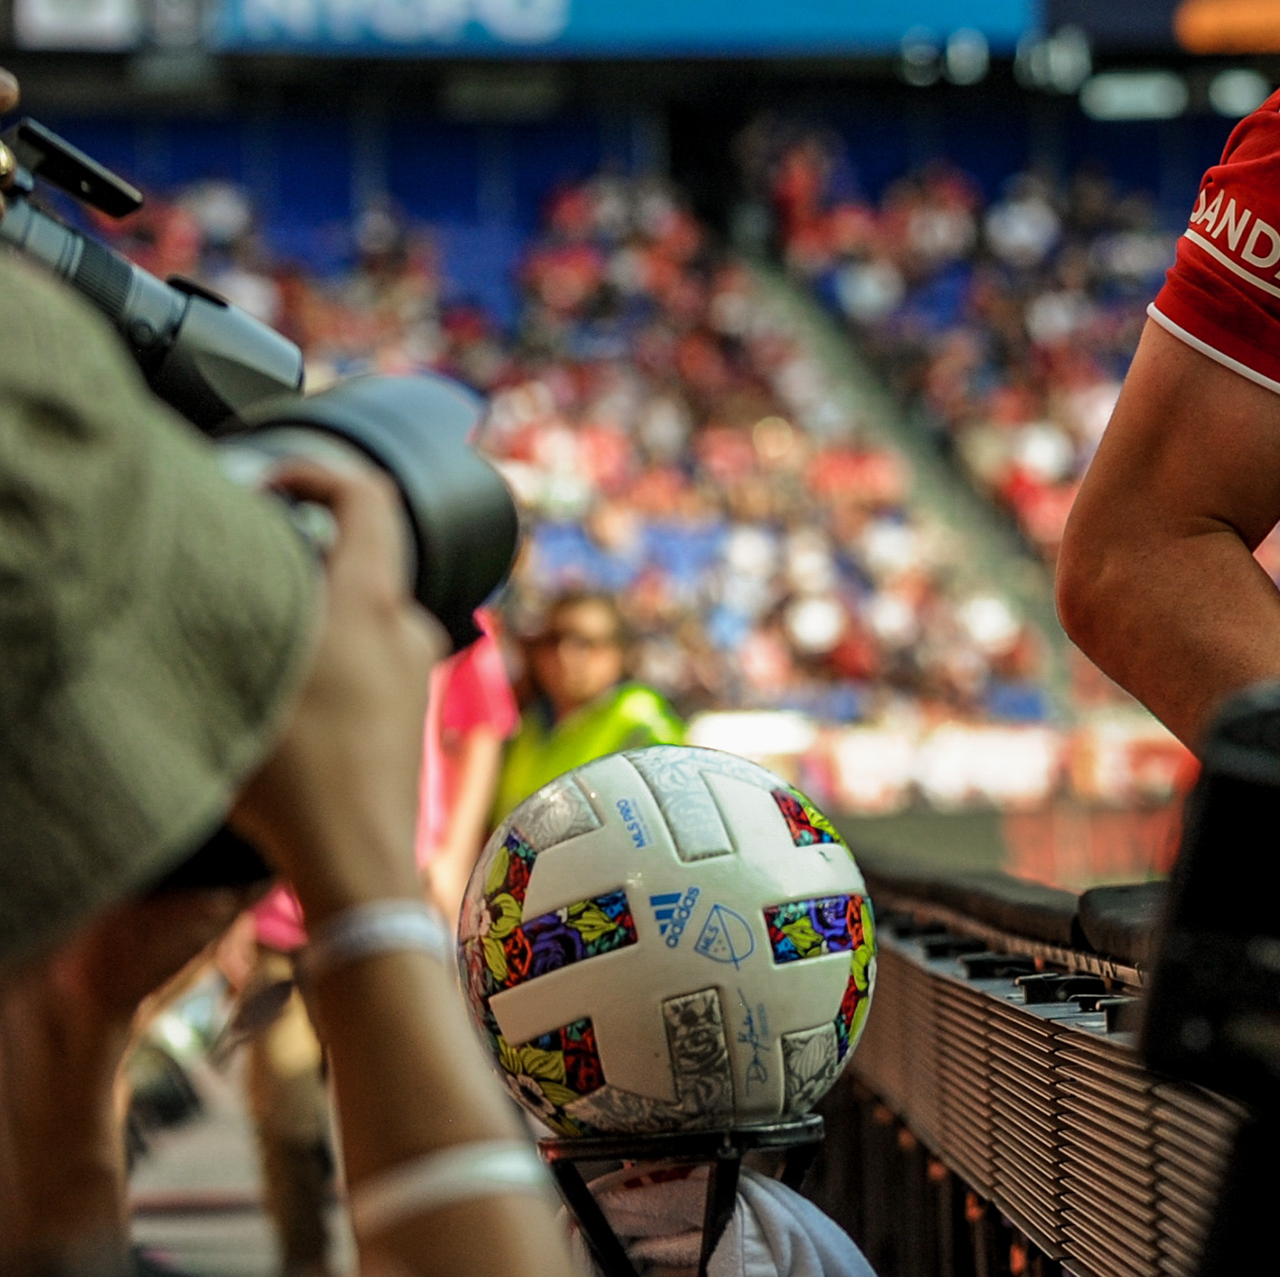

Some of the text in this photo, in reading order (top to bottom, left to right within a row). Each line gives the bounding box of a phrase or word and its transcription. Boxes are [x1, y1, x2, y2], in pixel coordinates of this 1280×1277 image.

[616, 798, 635, 822] PRO
[626, 822, 647, 849] MLS
[665, 886, 700, 949] adidas
[700, 924, 720, 953] MLS
